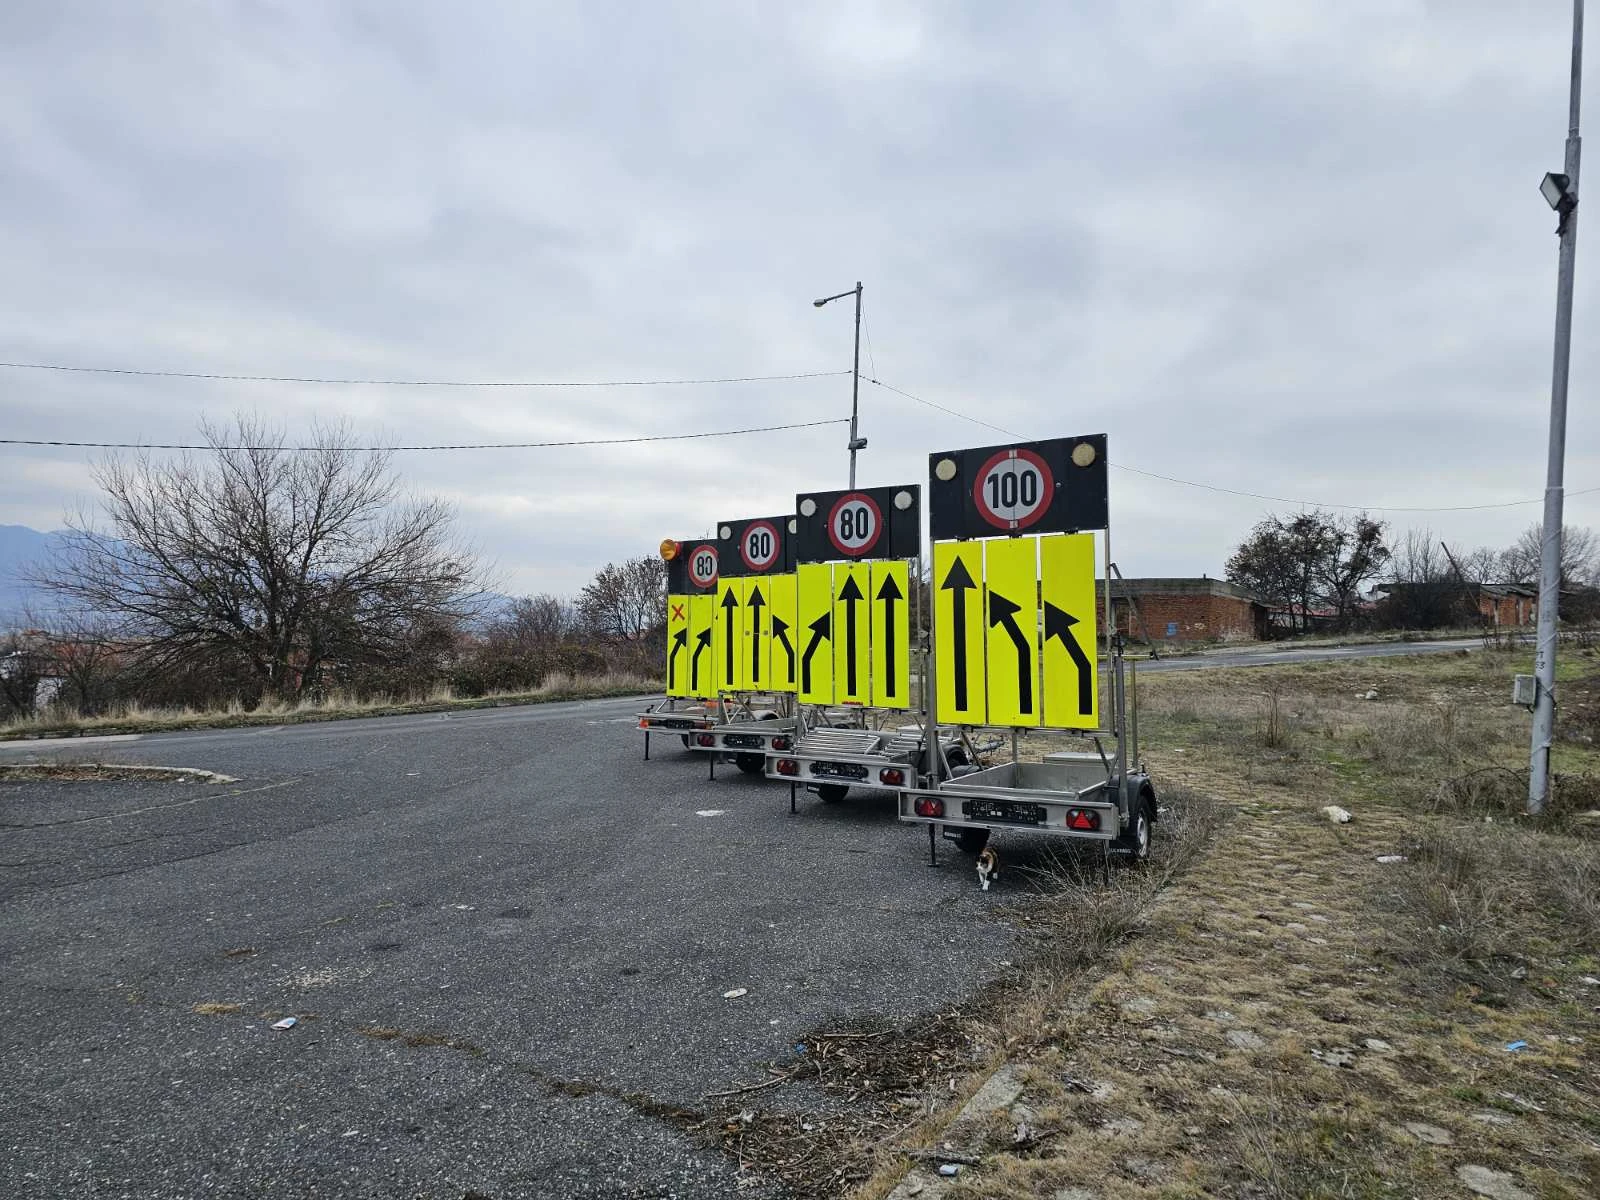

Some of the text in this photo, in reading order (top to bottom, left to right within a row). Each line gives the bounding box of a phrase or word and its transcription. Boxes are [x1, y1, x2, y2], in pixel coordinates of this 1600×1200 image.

[987, 470, 1037, 509] 100
[840, 507, 869, 540] 80
[750, 532, 770, 559] 80
[697, 555, 713, 577] 80
